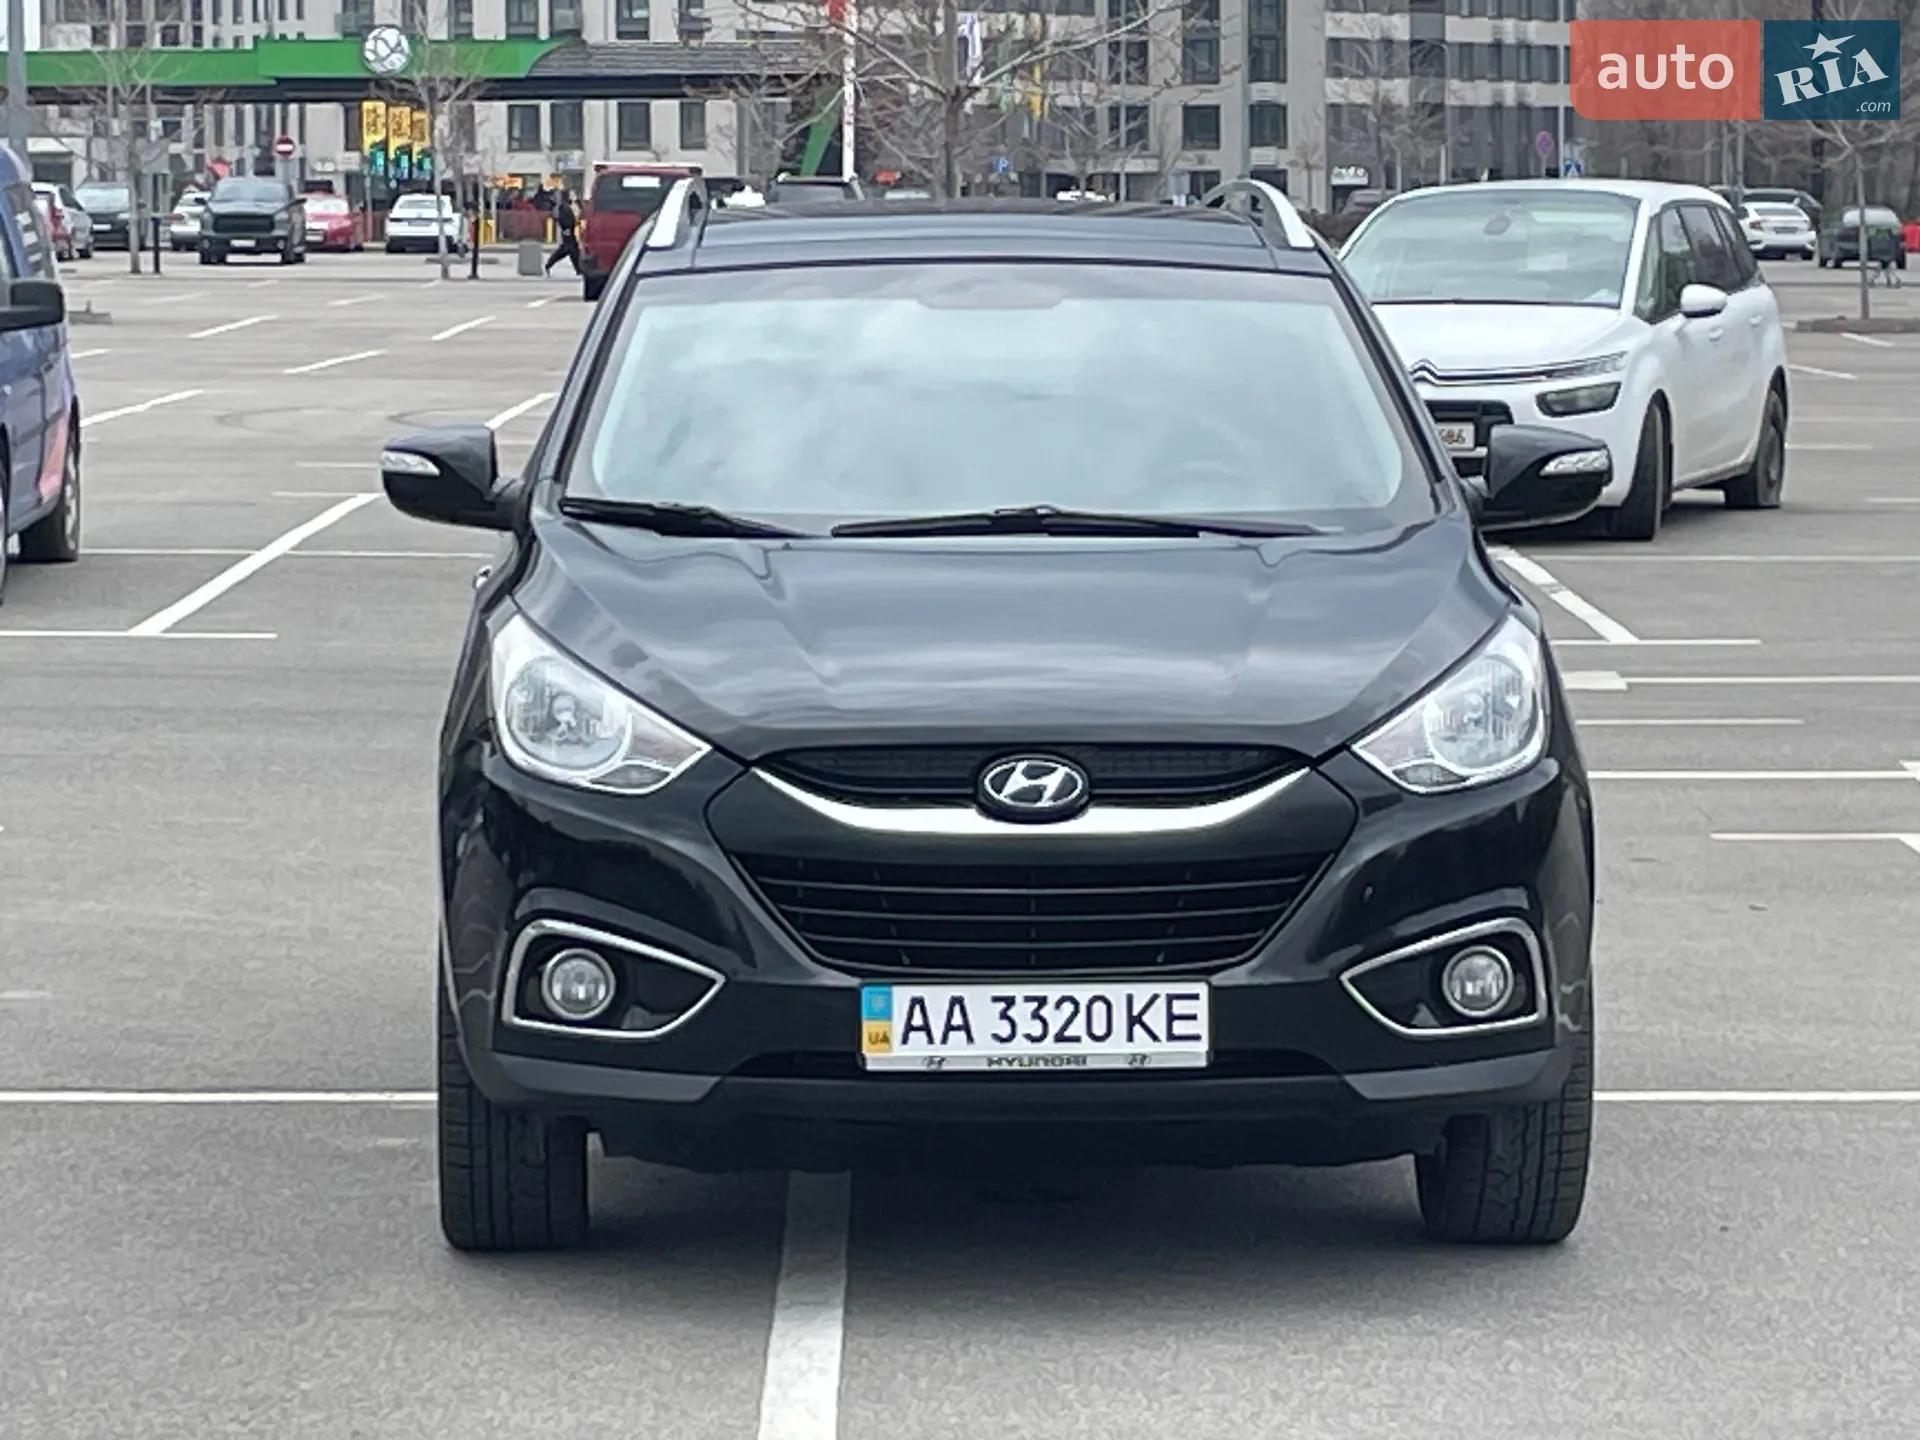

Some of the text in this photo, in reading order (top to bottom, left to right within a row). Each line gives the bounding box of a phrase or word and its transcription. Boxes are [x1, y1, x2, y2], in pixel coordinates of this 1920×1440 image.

[900, 992, 1203, 1045] AA 3320 KE
[868, 1031, 890, 1045] UA
[985, 1055, 1087, 1067] HYUNDAI
